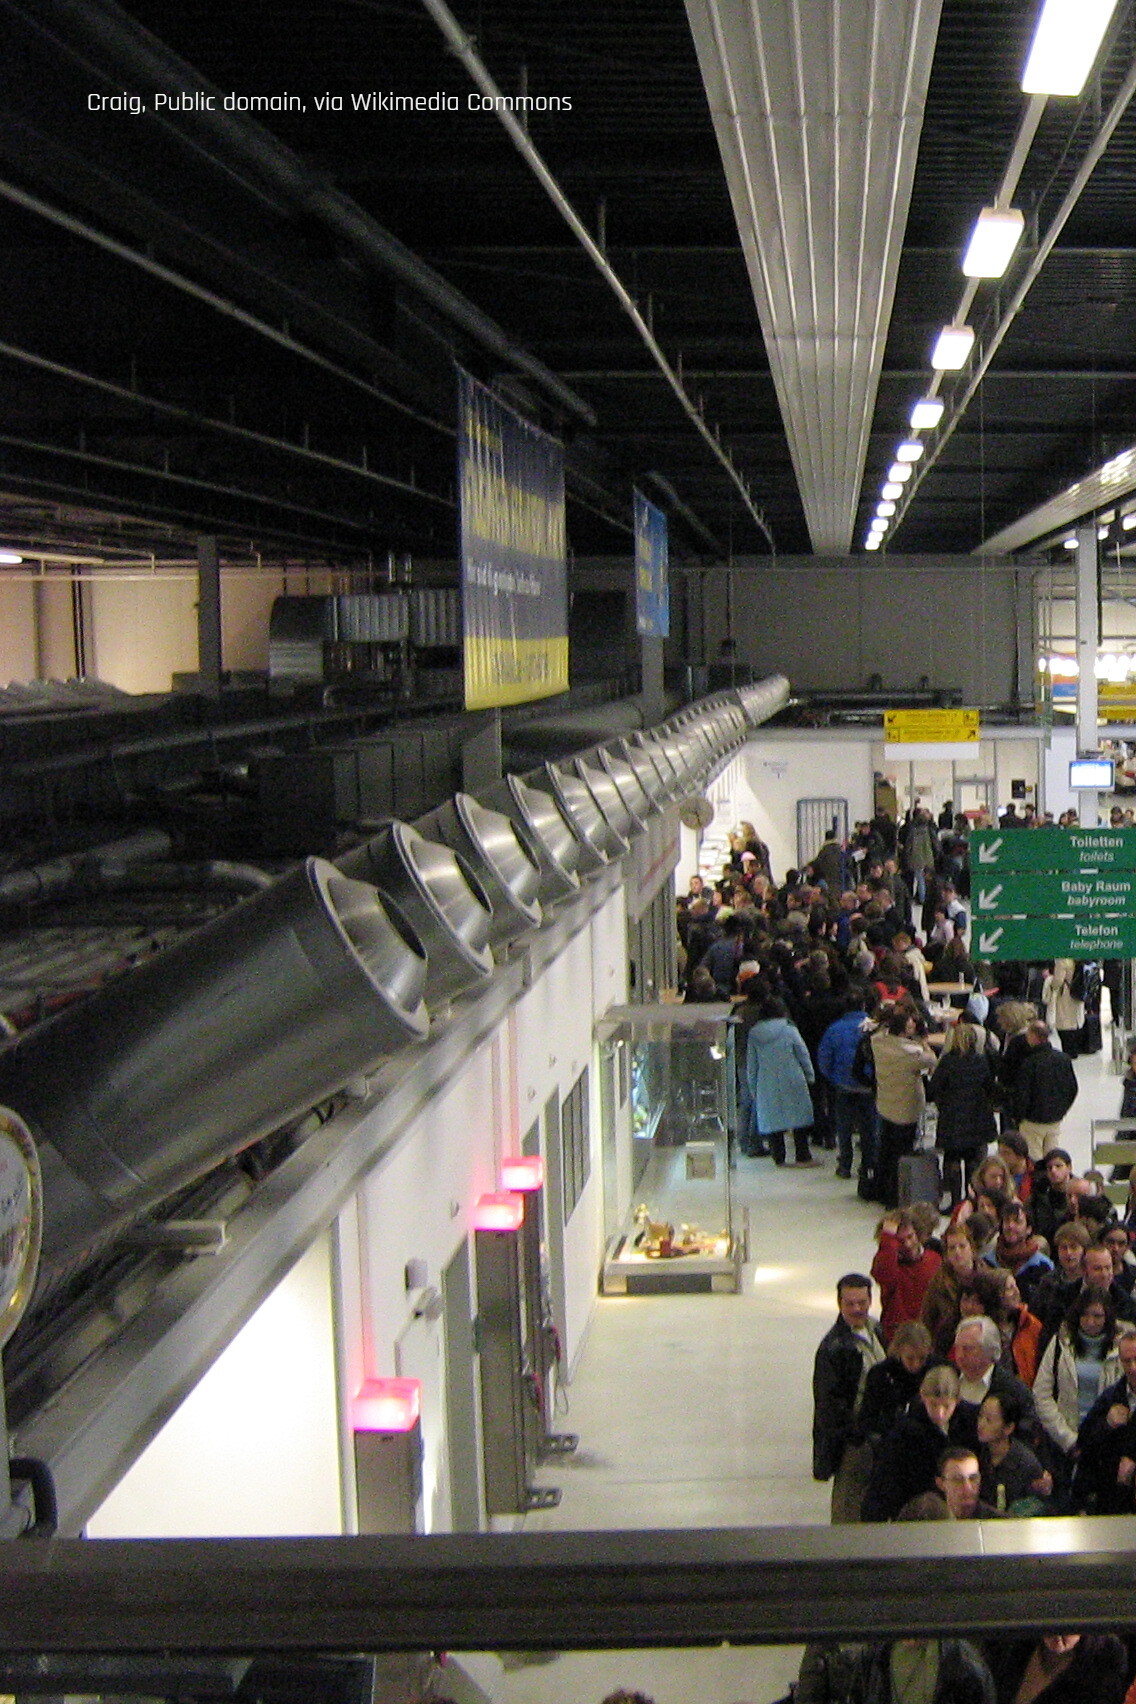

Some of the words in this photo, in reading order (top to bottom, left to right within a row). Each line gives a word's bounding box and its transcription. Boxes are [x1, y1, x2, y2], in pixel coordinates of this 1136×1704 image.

[1070, 836, 1123, 847] Toiletten
[1079, 851, 1114, 862] toilets
[1062, 881, 1093, 893] Baby
[1096, 881, 1130, 891] Raum
[1067, 895, 1125, 906] babyroom
[1075, 925, 1118, 936] Telefon
[1070, 940, 1123, 951] telephone
